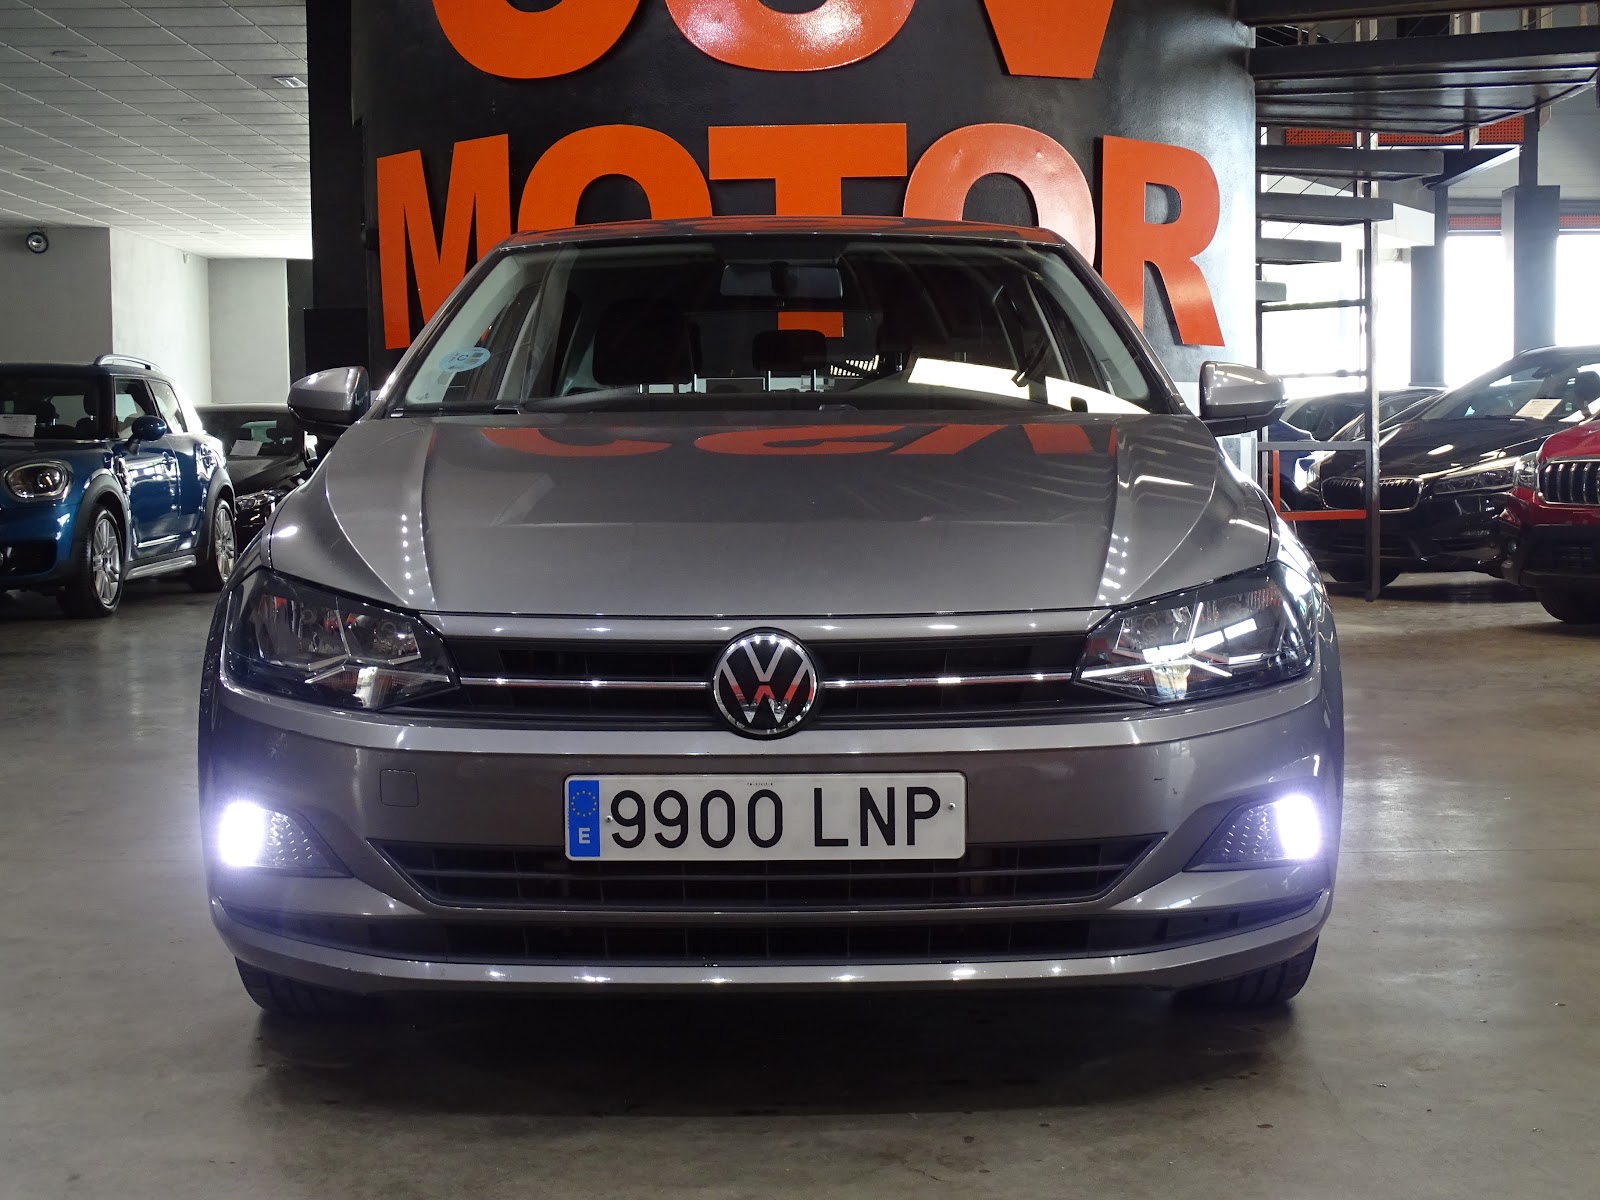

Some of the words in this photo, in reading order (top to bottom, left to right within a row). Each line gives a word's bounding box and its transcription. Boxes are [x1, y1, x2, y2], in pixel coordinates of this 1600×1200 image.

[719, 638, 810, 724] VW
[578, 827, 591, 844] E
[610, 789, 783, 849] 9900
[813, 786, 941, 847] LNP
